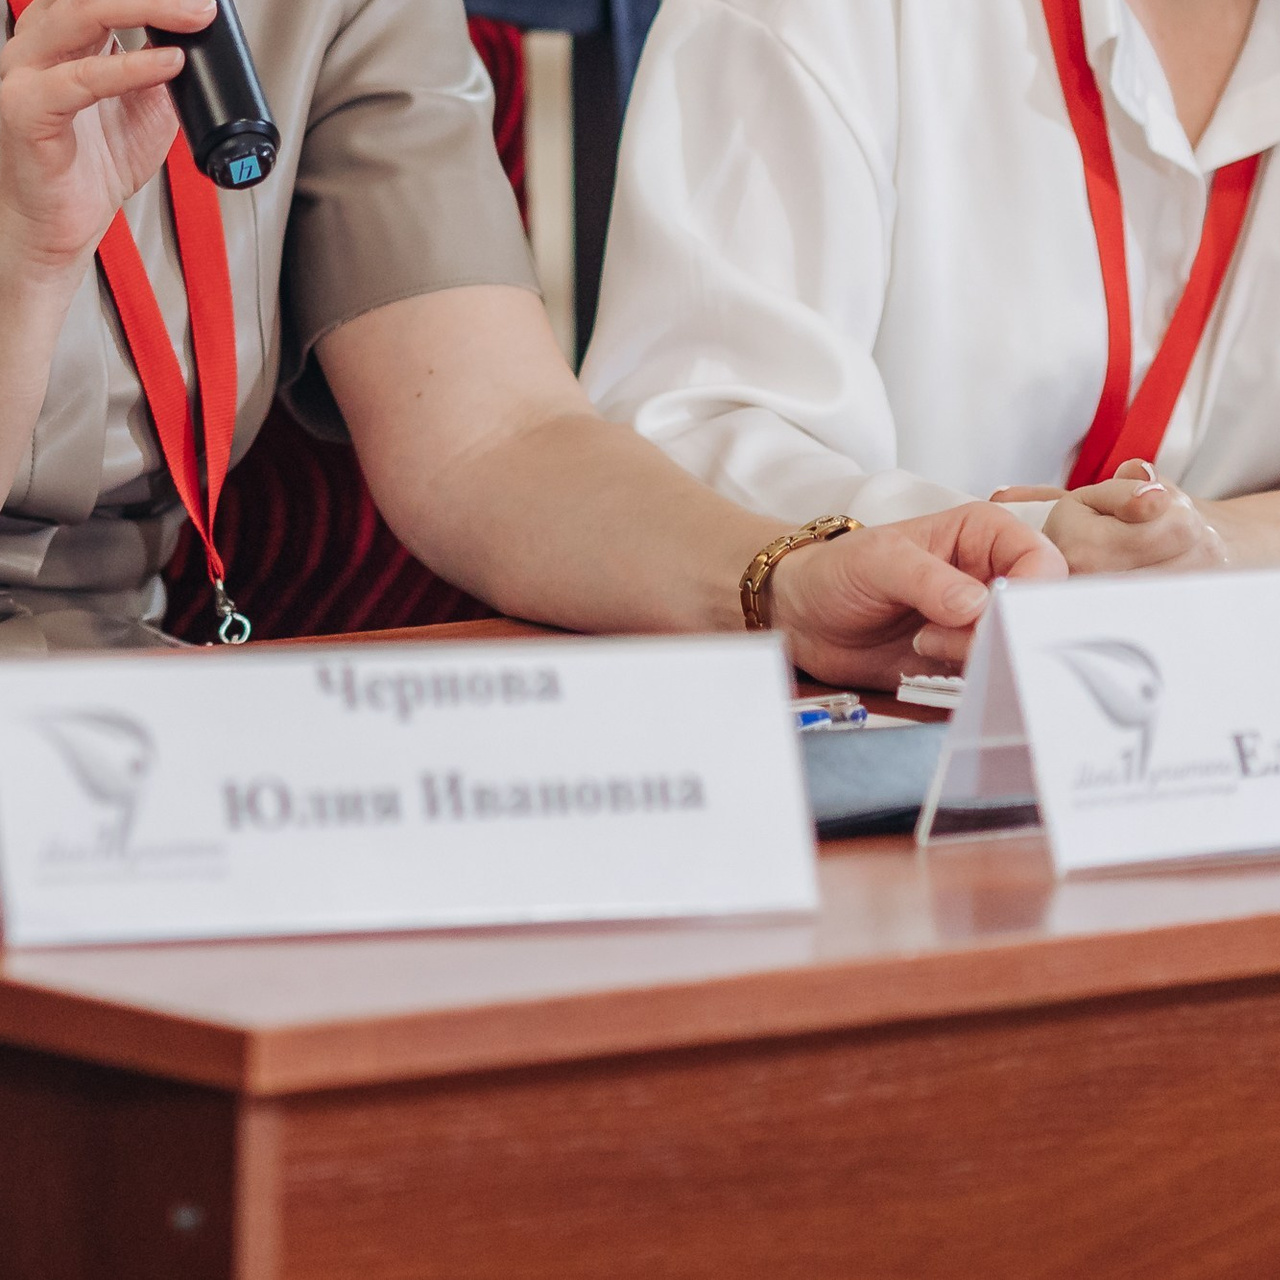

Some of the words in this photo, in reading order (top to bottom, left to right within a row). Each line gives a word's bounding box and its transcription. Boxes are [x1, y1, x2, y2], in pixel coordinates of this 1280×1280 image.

[315, 661, 564, 724] Чернова
[221, 775, 403, 832] Юлия
[420, 768, 708, 820] Ивановна
